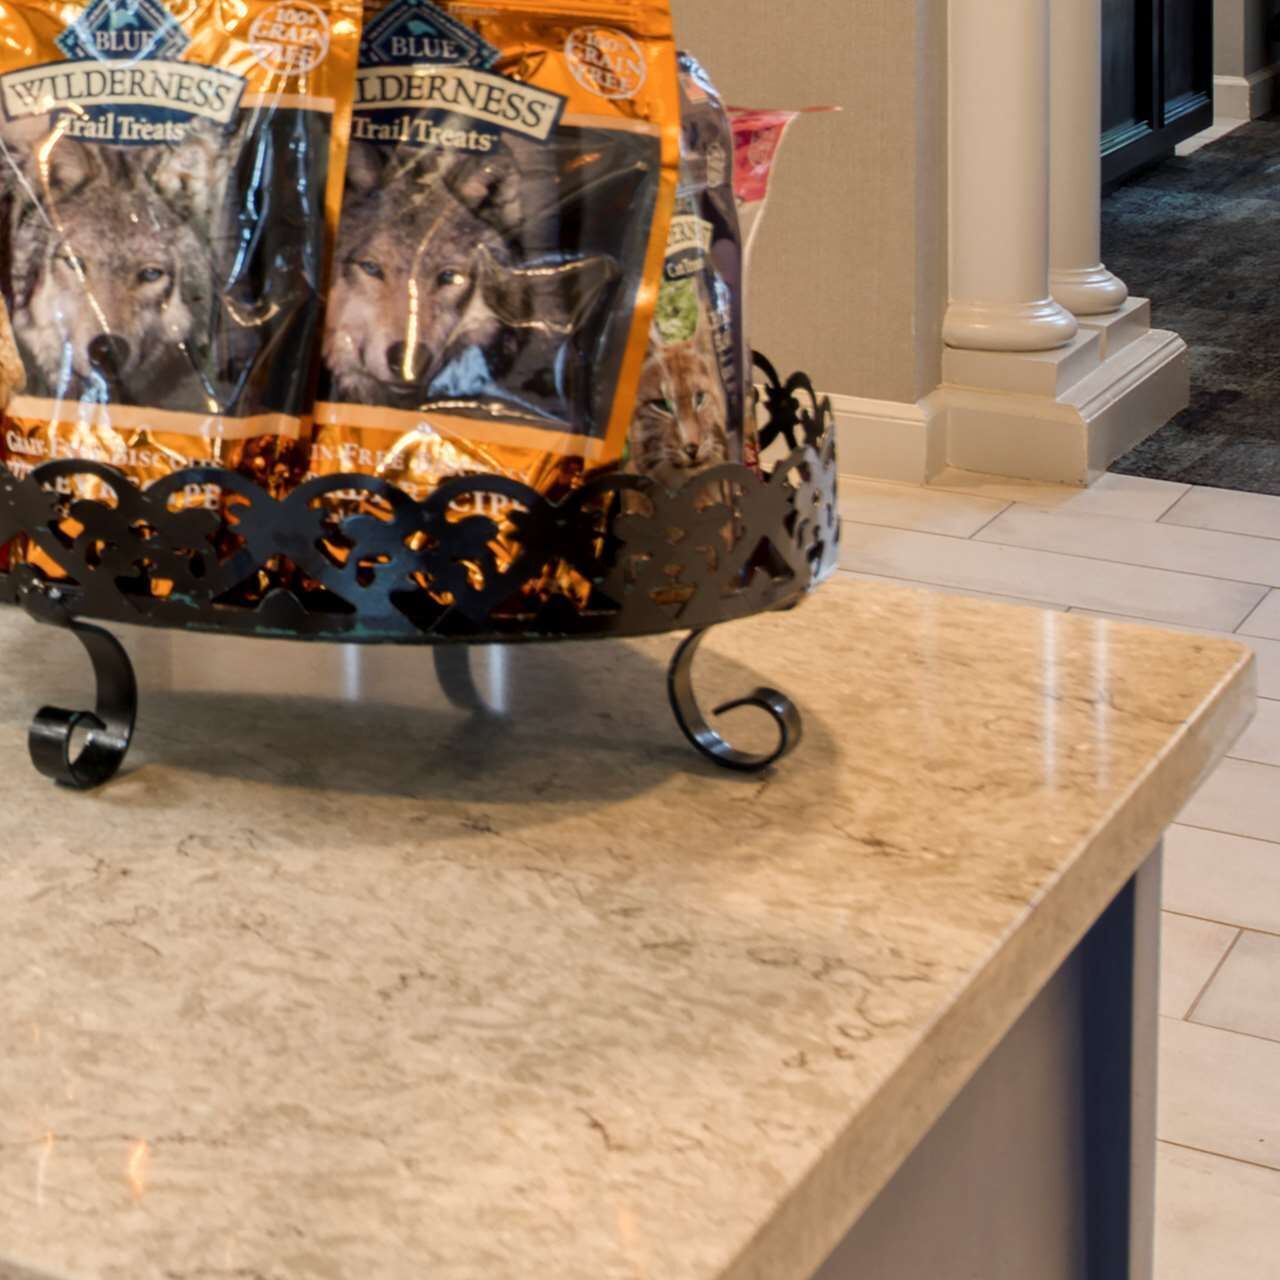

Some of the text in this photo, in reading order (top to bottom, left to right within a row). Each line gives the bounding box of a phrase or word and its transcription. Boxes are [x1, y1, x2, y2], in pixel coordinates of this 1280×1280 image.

[94, 29, 155, 53] BLUE
[254, 20, 326, 43] GRAIN
[389, 35, 460, 59] BLUE
[8, 67, 233, 114] WILDERNESS
[357, 74, 548, 129] LDERNESS
[58, 111, 115, 141] Trail
[352, 115, 493, 153] Trail Treats
